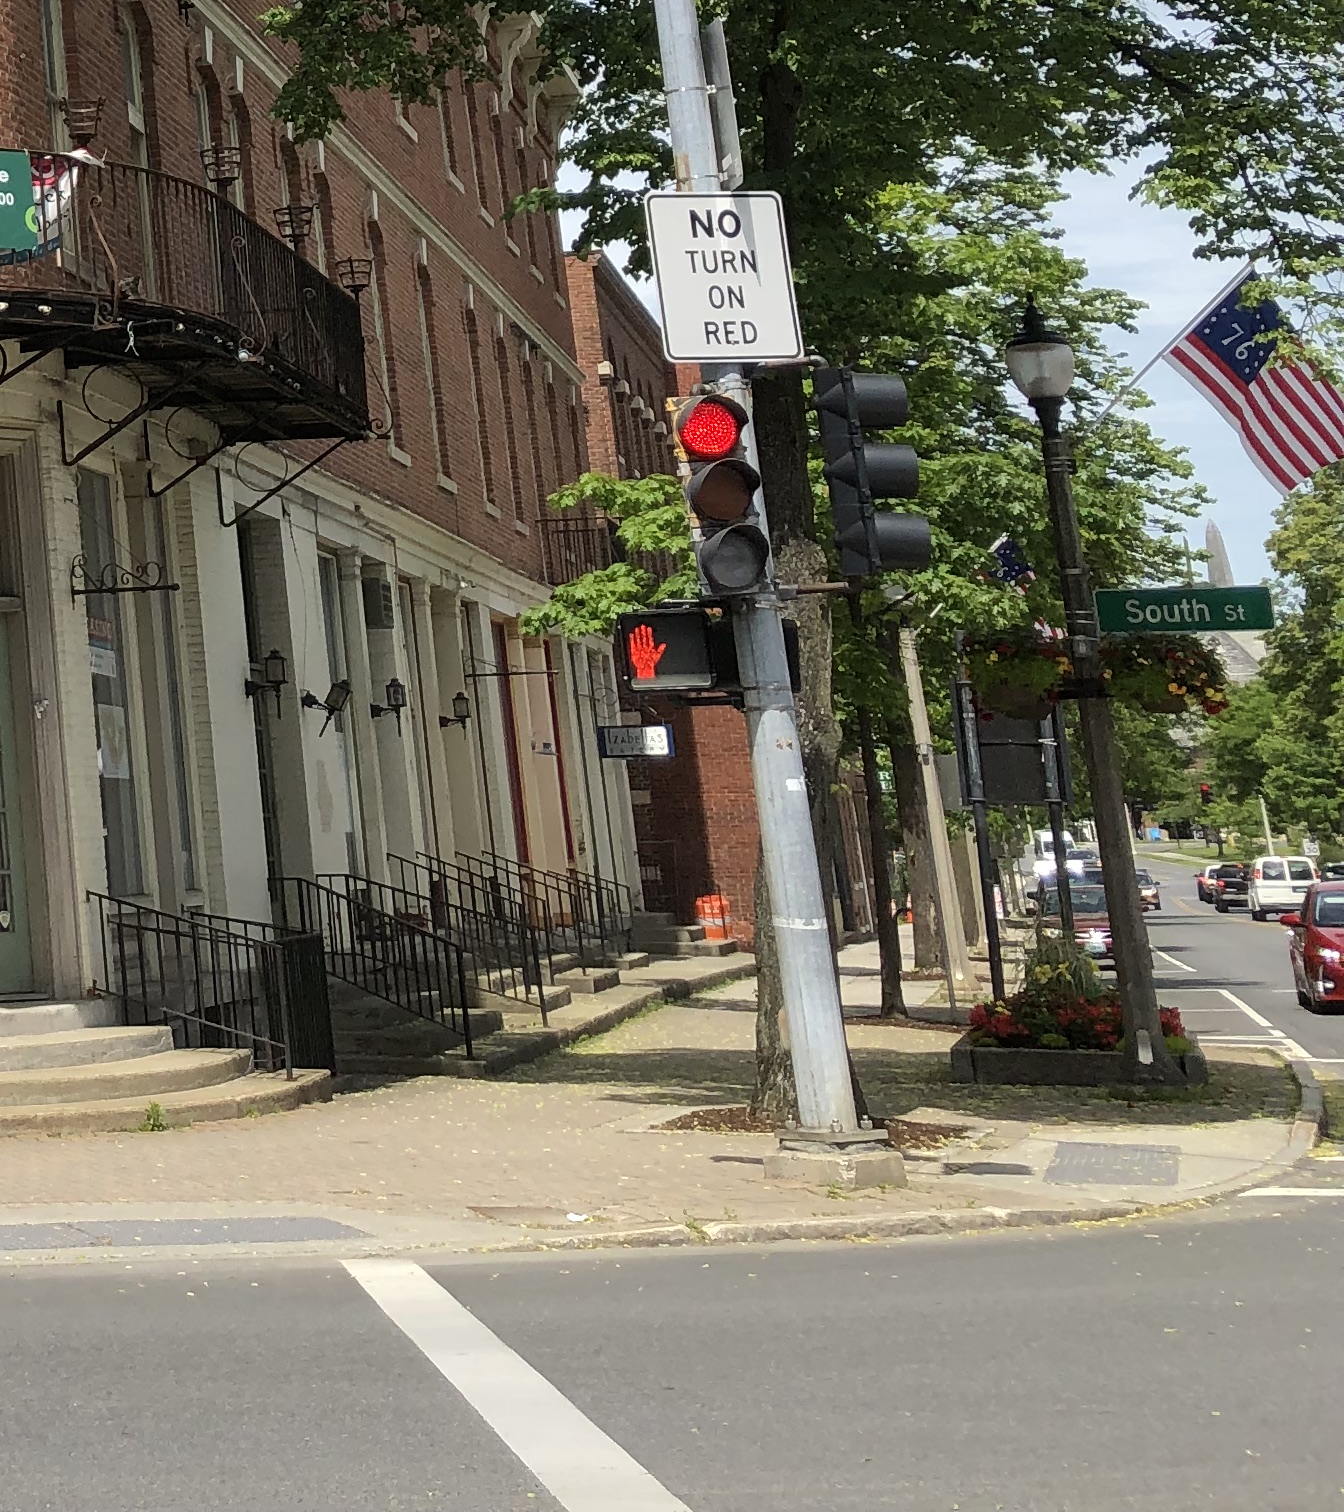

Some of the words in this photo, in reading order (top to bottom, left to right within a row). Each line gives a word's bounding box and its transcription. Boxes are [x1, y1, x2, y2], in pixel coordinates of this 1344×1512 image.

[688, 209, 742, 239] NO
[684, 249, 758, 274] TURN
[708, 284, 746, 310] ON
[703, 320, 758, 346] RED
[1124, 598, 1211, 624] South
[1223, 603, 1246, 623] St
